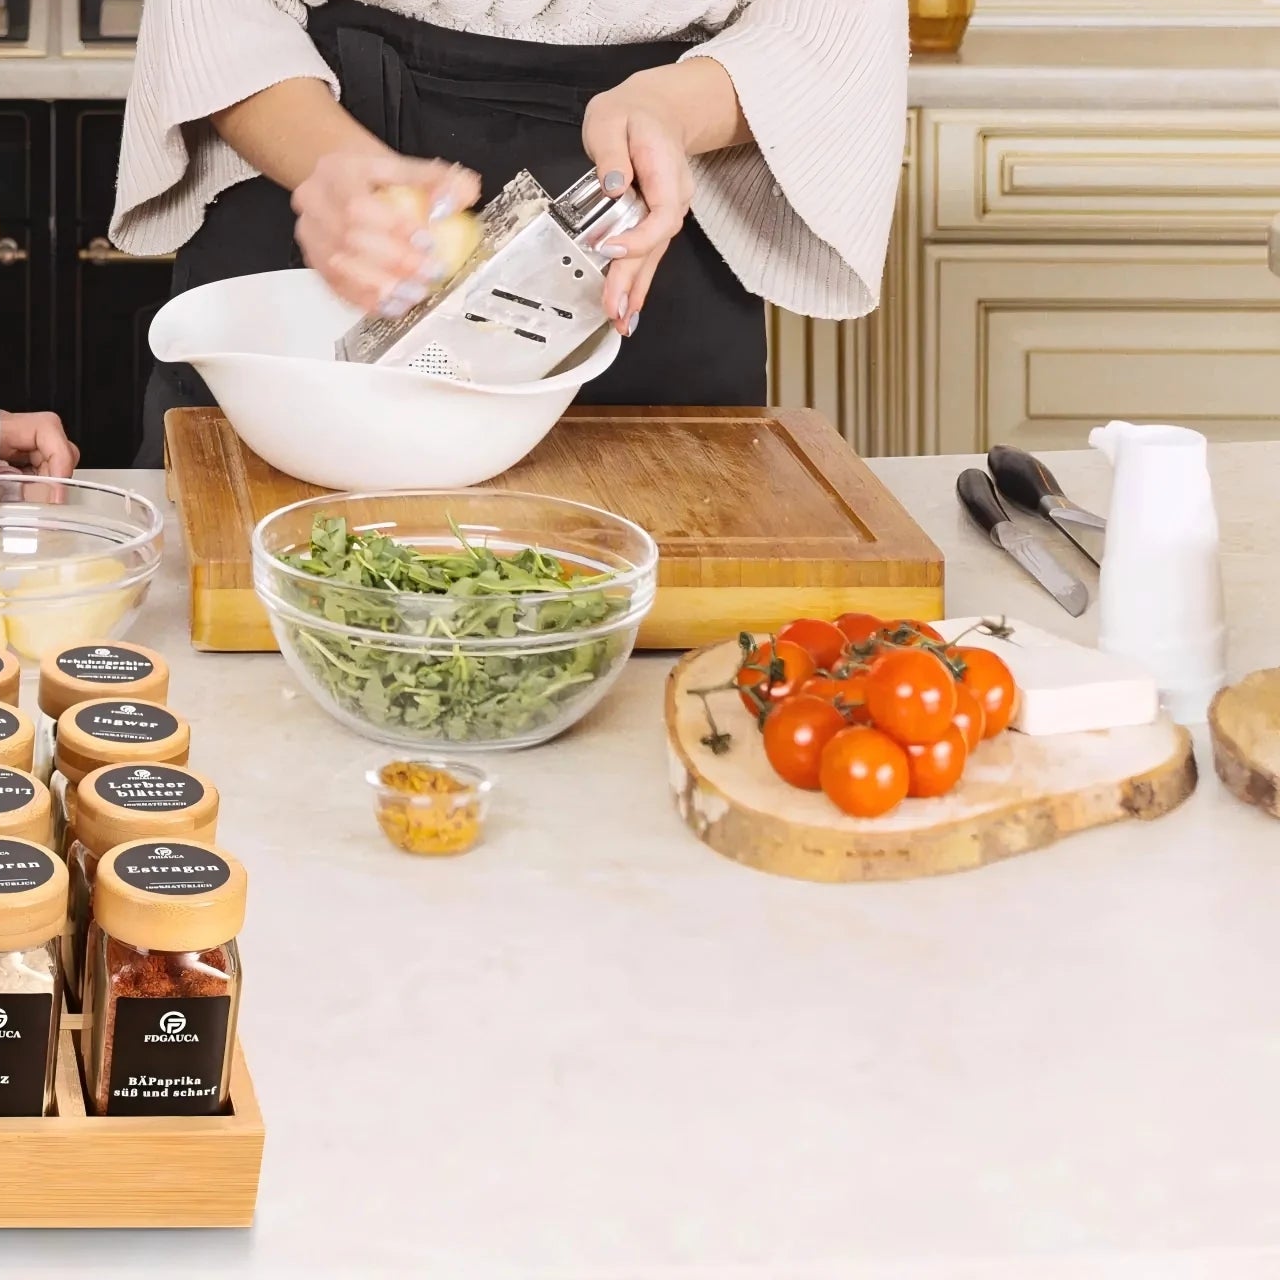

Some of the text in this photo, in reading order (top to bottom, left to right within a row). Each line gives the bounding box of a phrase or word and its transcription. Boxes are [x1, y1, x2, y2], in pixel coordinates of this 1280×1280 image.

[93, 716, 158, 728] Ingwer
[108, 780, 186, 790] Lorbeer
[116, 788, 183, 798] blätter
[127, 863, 220, 874] Estragon
[144, 1033, 200, 1043] FDGAUCA
[128, 1075, 201, 1088] BÄPaprika
[113, 1083, 218, 1098] süß und scharf
